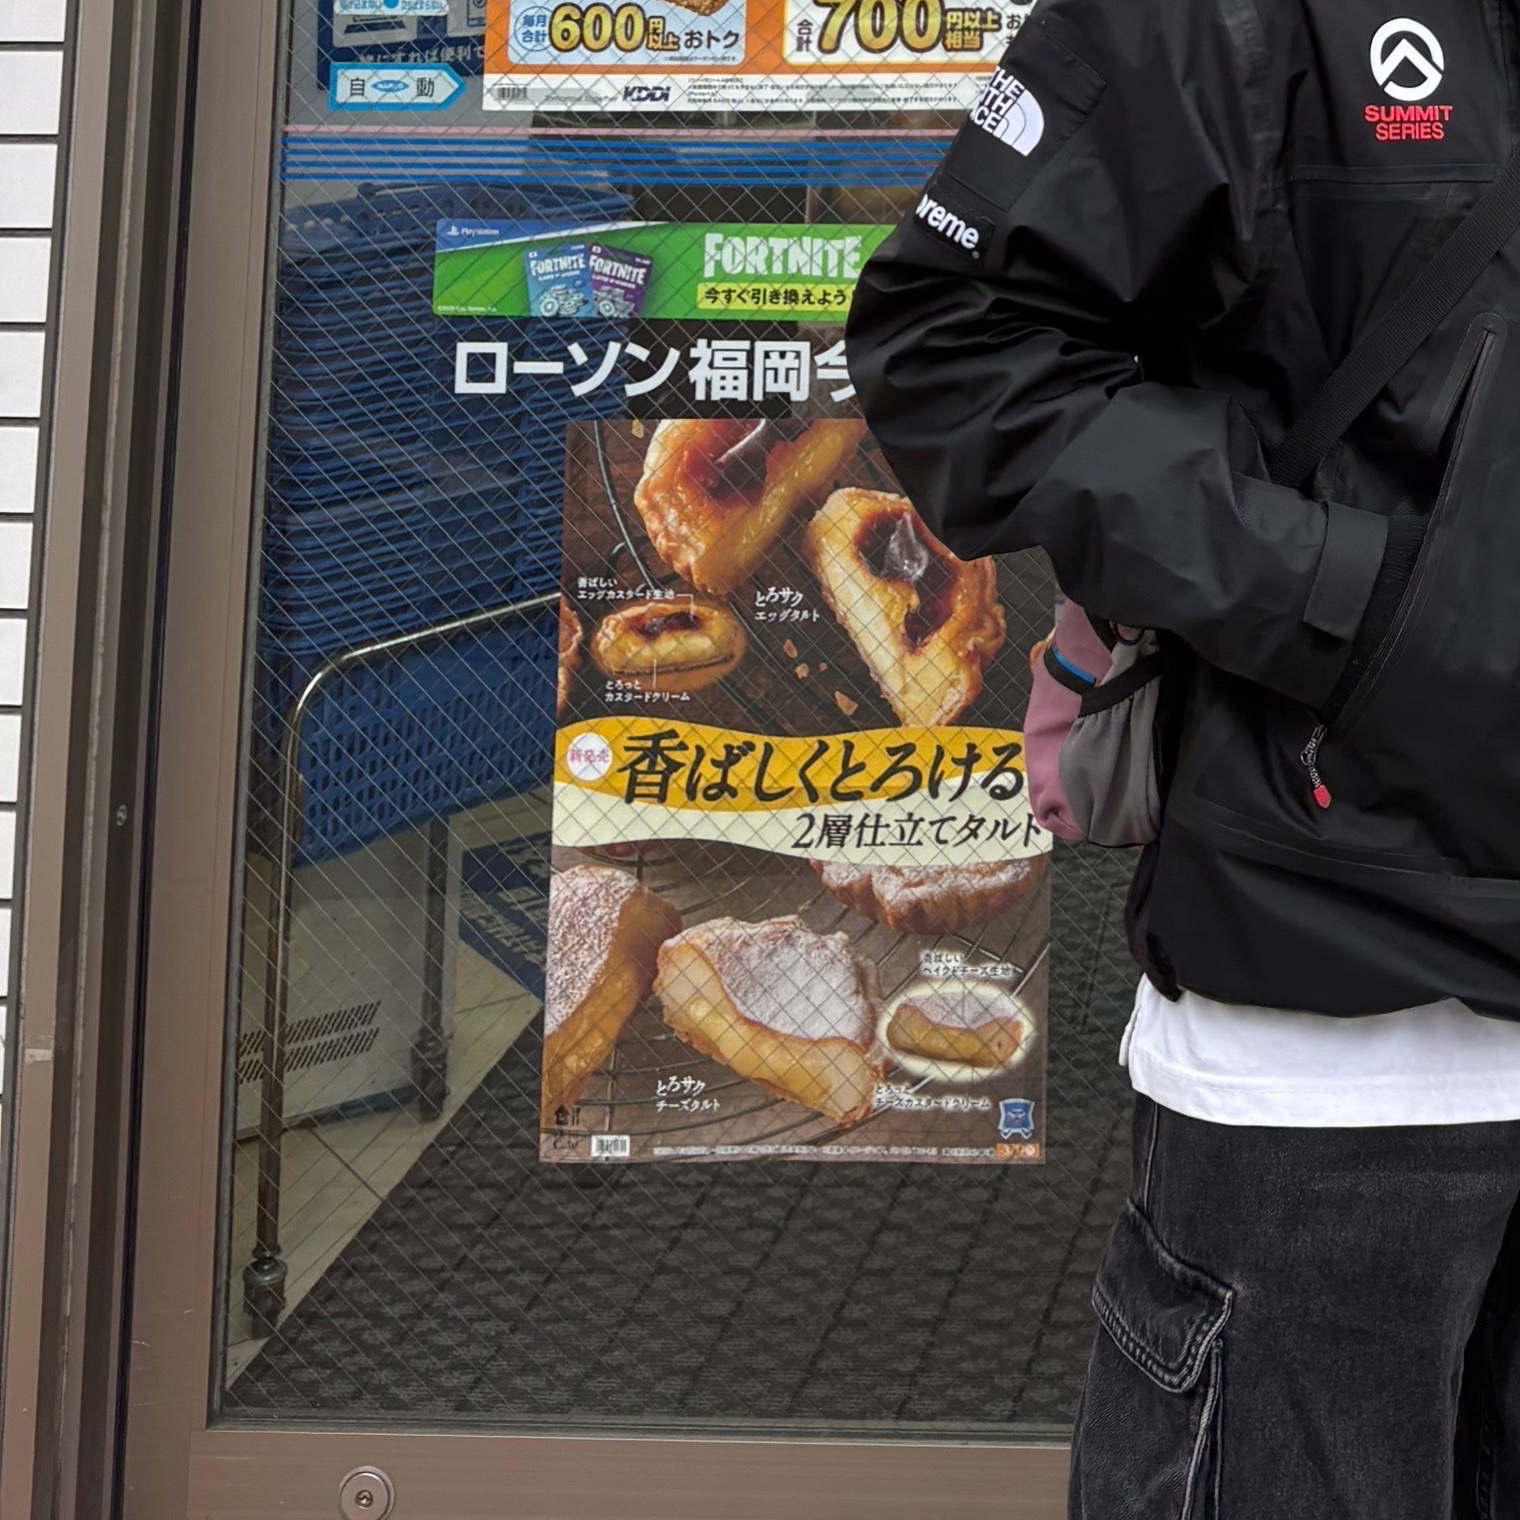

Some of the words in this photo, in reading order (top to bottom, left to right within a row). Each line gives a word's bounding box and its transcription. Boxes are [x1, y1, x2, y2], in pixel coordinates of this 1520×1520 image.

[521, 14, 547, 28] 毎月
[551, 3, 645, 52] 600
[946, 12, 1000, 31] 円以上
[685, 30, 740, 49] おトク
[797, 20, 813, 52] 合計
[945, 32, 984, 50] 相当
[622, 86, 671, 103] KDDI
[1364, 105, 1453, 123] SUMMIT
[1376, 123, 1445, 141] SERIES
[529, 254, 586, 277] FORTNITE
[704, 233, 864, 279] FORTNITE
[589, 254, 647, 286] FORTNITE
[704, 286, 847, 307] 今すぐ引き換えよう
[577, 577, 618, 589] 香ばしい
[754, 586, 805, 608] とろサク
[754, 610, 821, 623] エッグタルト
[605, 680, 643, 690] とろっと
[604, 692, 691, 703] カスタードクリーム
[568, 747, 613, 765] 新発売
[617, 728, 1025, 805] 香ばしくとろける
[791, 811, 1043, 850] 2層仕立てタルト
[656, 1075, 707, 1097] とろサク
[656, 1098, 721, 1113] チーズタルト
